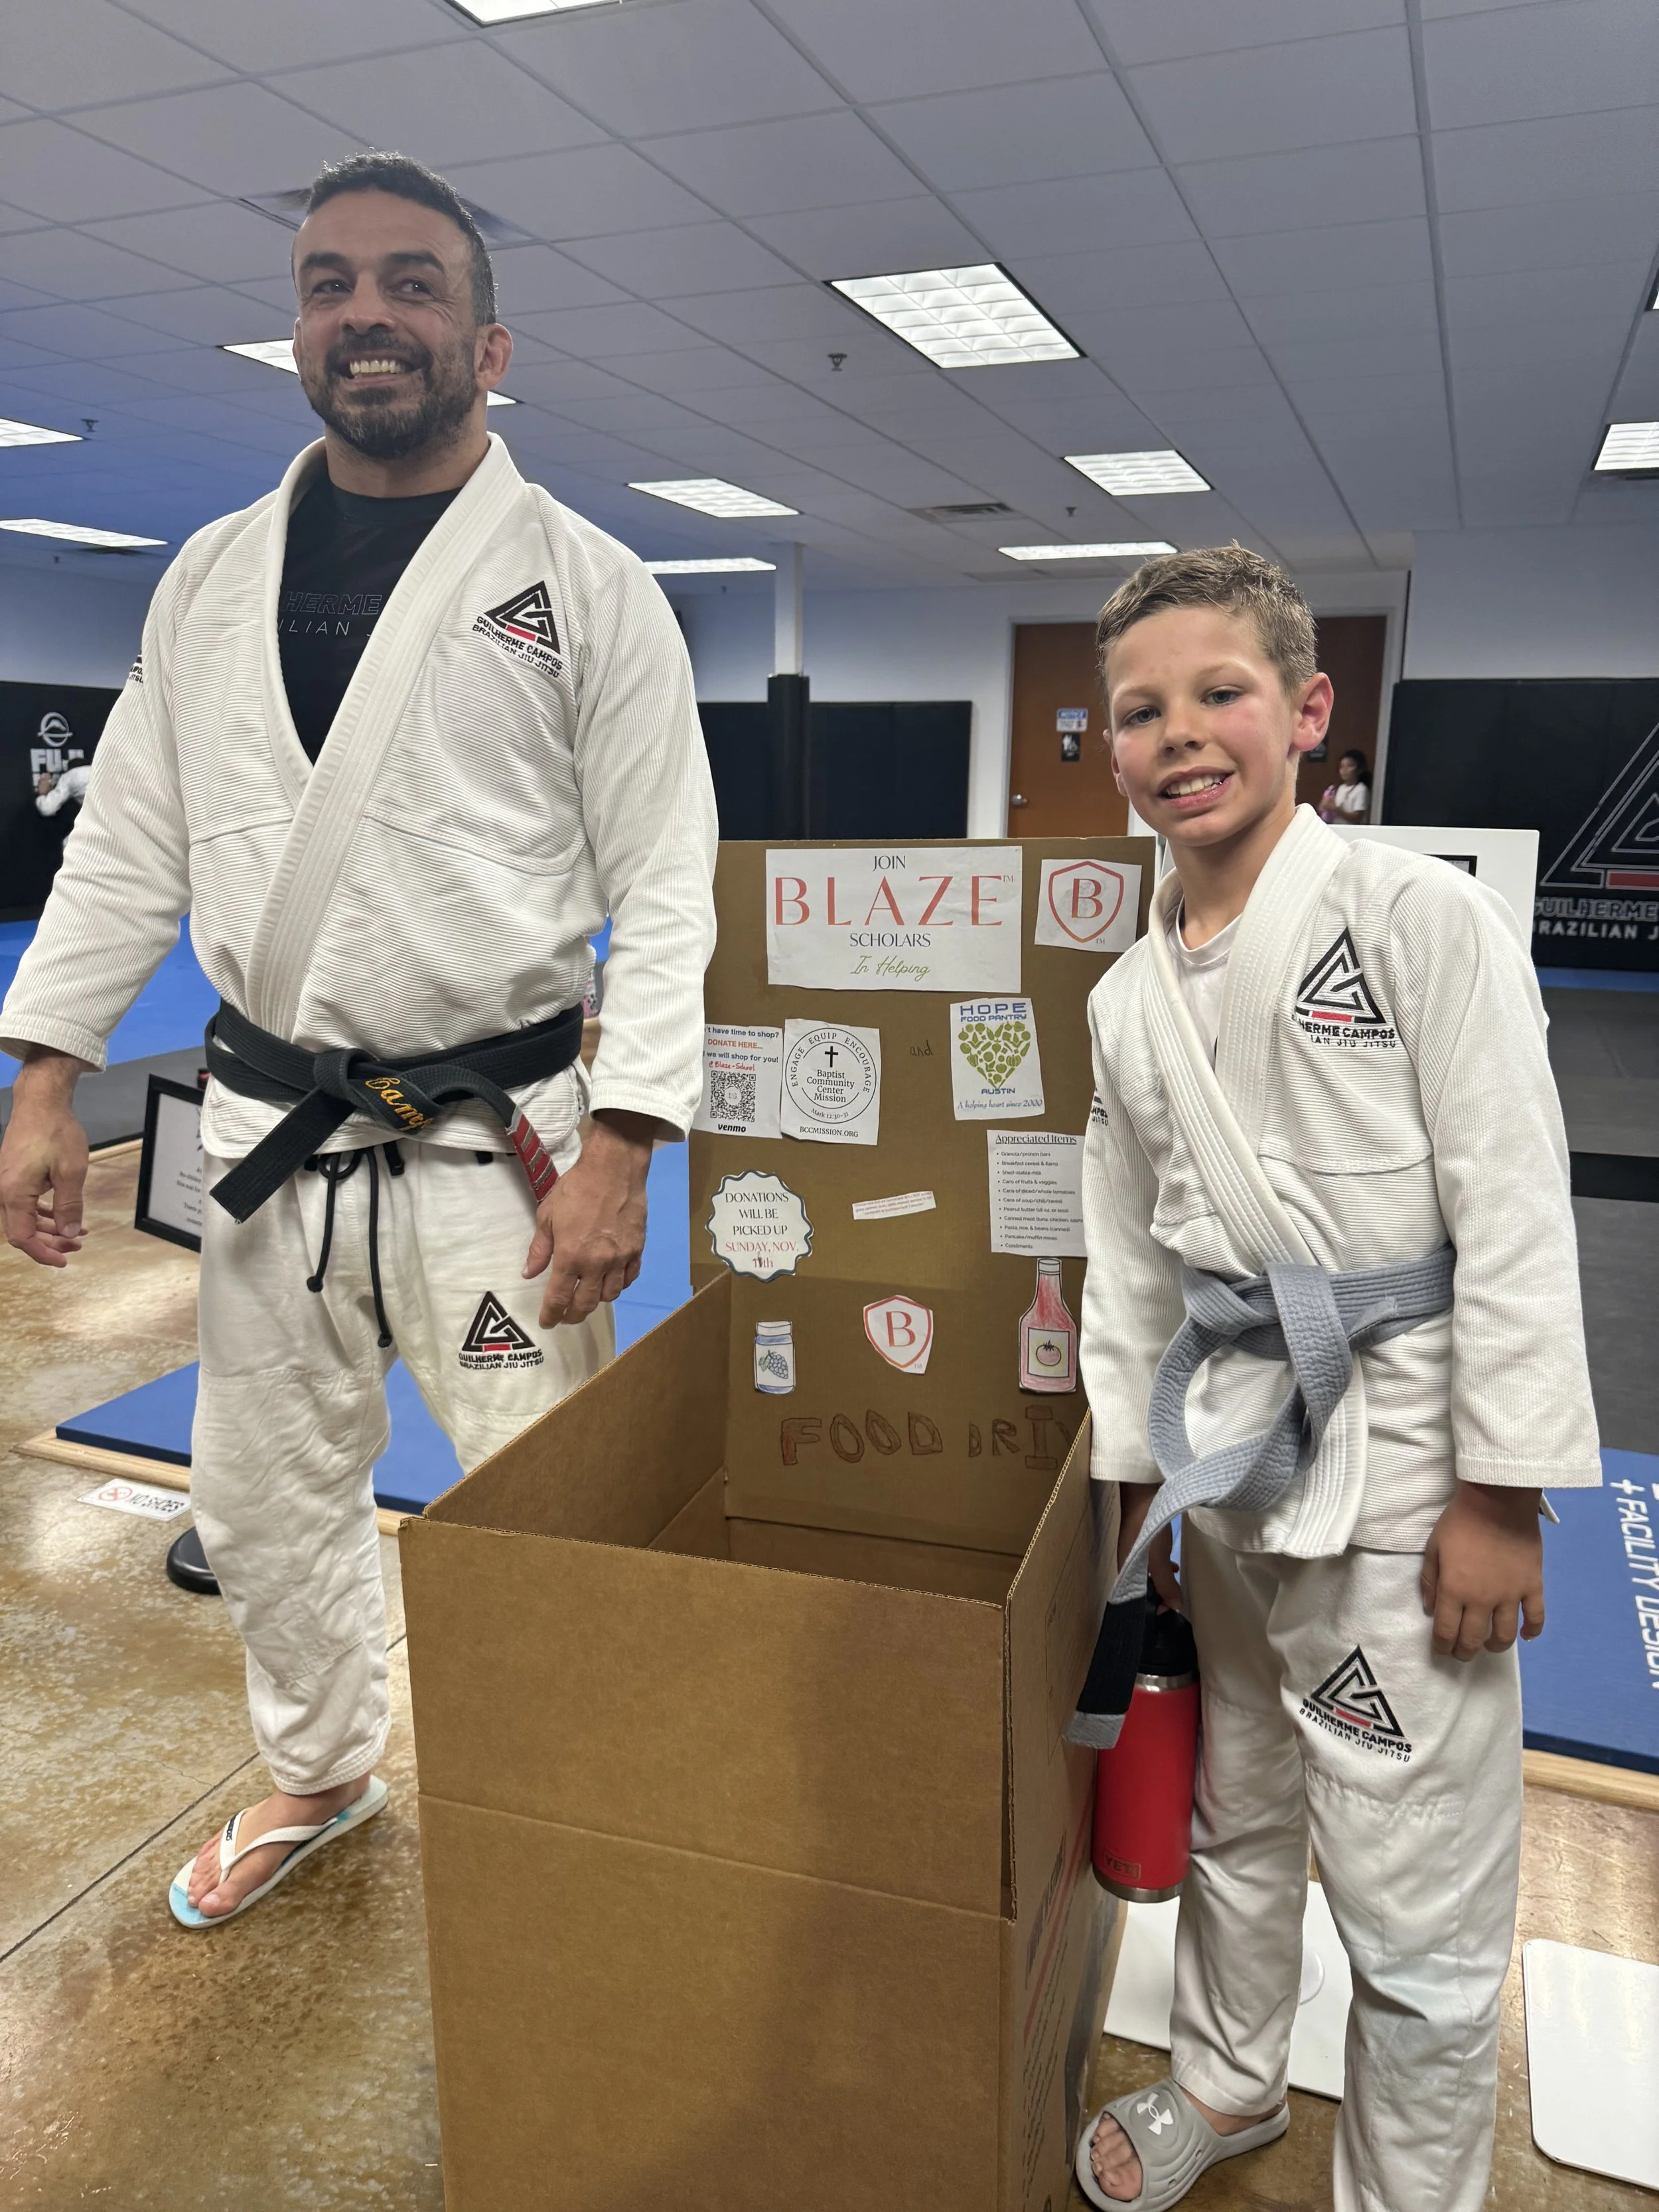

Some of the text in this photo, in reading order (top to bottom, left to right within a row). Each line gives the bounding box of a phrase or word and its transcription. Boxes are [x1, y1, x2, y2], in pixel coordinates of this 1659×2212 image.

[476, 616, 563, 670] GUILHERME CAMPOS
[472, 624, 559, 678] BRAZILIAN JIU JITSU
[872, 855, 906, 871] JOIN
[775, 875, 1003, 926] BLAZE
[1072, 878, 1104, 919] B
[1532, 919, 1638, 940] RAZILIAN
[849, 932, 931, 948] SCHOLARS
[850, 955, 930, 982] In Helping
[960, 1003, 1027, 1015] HOPE
[808, 1032, 837, 1045] EQUIP
[1343, 1027, 1395, 1039] CAMPOS
[707, 1038, 737, 1047] DONATE
[909, 1039, 934, 1057] and
[1337, 1039, 1356, 1047] JIU
[790, 1047, 805, 1087] ENGAGE
[844, 1037, 872, 1093] ENCOURAGE
[817, 1069, 845, 1079] Baptist
[806, 1076, 855, 1090] Community
[817, 1086, 844, 1094] Center
[814, 1092, 847, 1102] Mission
[965, 1100, 987, 1109] helping
[811, 1108, 826, 1118] Mark
[717, 1124, 747, 1133] venmo
[800, 1126, 859, 1138] BCCMISSION.ORG
[995, 1134, 1077, 1144] Appreciated Items
[725, 1192, 789, 1203] DONATIONS
[739, 1209, 779, 1218] WILL BE
[733, 1225, 788, 1235] PICKED UP
[772, 1241, 799, 1252] NOV.
[885, 1310, 916, 1347] B
[459, 1349, 542, 1363] GUILHERME CAMPOS
[520, 1356, 544, 1368] JITSU
[780, 1408, 944, 1465] FOOD
[1303, 1698, 1412, 1753] GUILHERME CAMPOS
[1299, 1708, 1411, 1763] BRAZILIAN JIU JITSU
